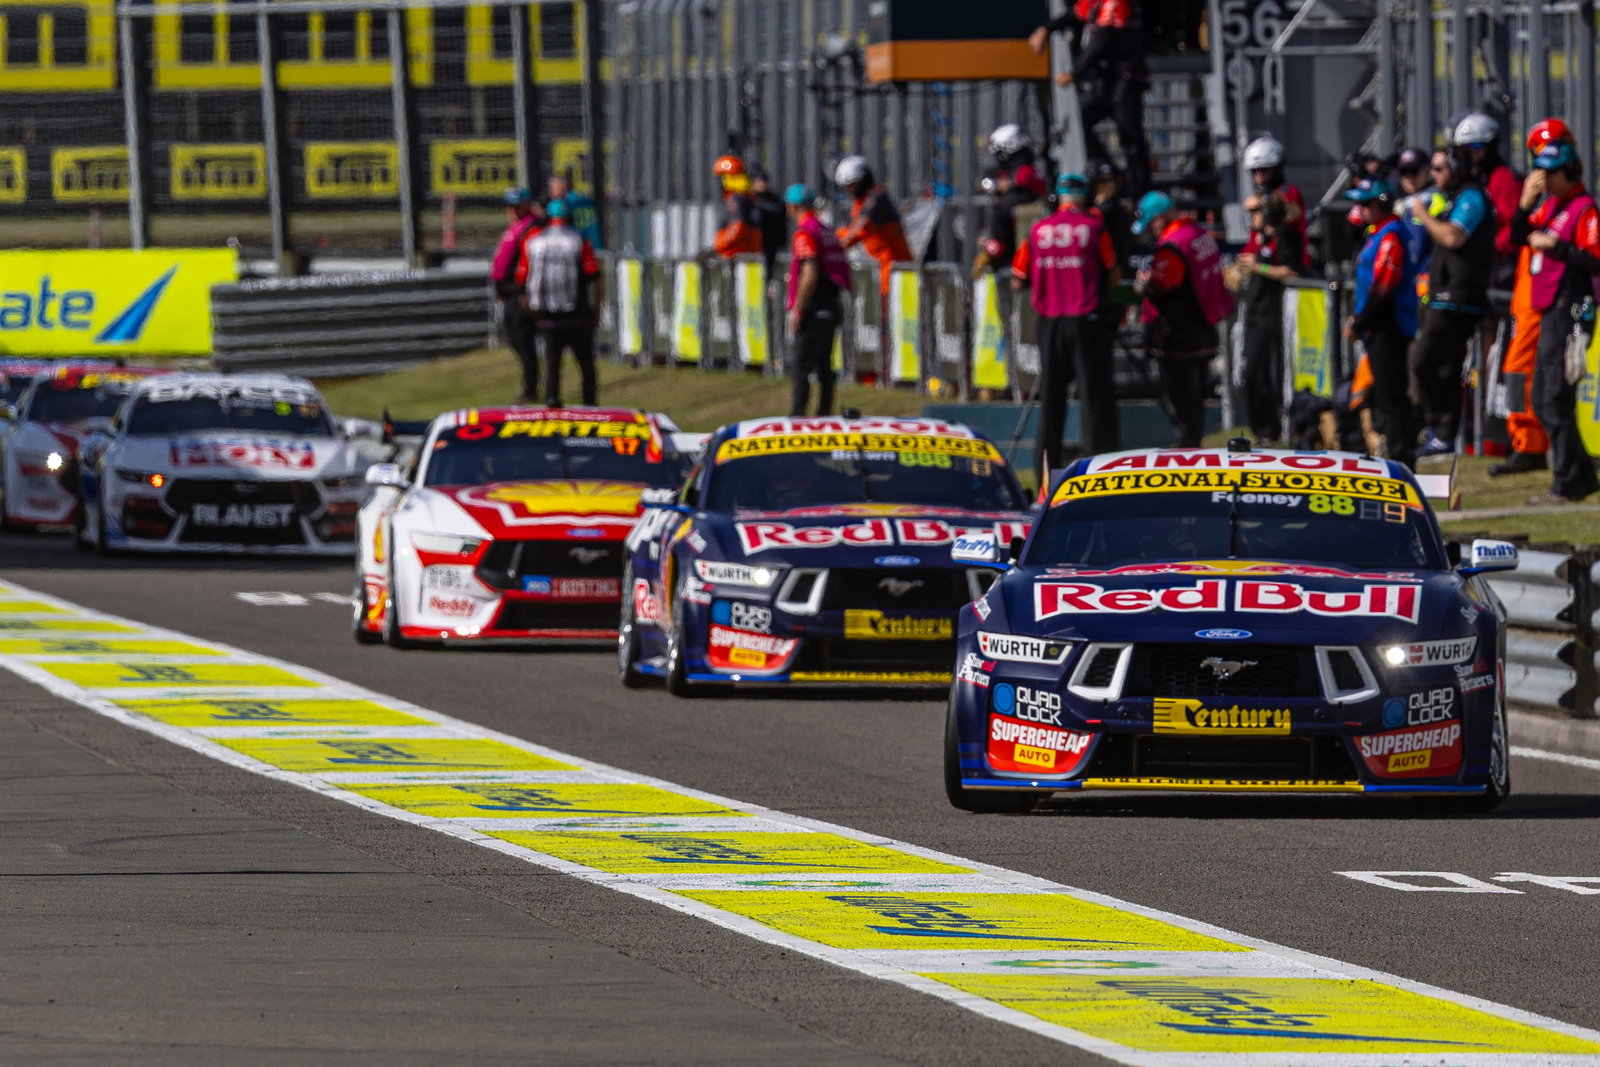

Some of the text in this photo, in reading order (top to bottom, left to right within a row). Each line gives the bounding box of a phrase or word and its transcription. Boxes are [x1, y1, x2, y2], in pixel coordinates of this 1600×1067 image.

[1036, 223, 1090, 249] 331
[0, 274, 94, 330] ate
[746, 421, 967, 437] AMPOL
[728, 434, 857, 454] NATIONAL
[899, 451, 953, 469] 888
[1096, 453, 1383, 475] AMPOL
[1065, 472, 1401, 499] NATIONAL STORAGE
[1308, 493, 1356, 516] 88
[735, 518, 895, 556] Red
[1475, 544, 1518, 558] Thrifty
[1034, 579, 1227, 622] Red
[1234, 580, 1423, 625] Bull
[1204, 628, 1242, 638] Ford
[989, 637, 1041, 658] WÜRTH
[1427, 642, 1472, 661] WÜRTH
[1016, 686, 1061, 710] QUAD
[1408, 687, 1454, 709] QUAD
[1016, 702, 1062, 726] LOCK
[1153, 697, 1292, 736] Century
[1408, 703, 1454, 726] LOCK
[991, 718, 1091, 754] SUPERCHEAP
[1360, 723, 1461, 758] SUPERCHEAP
[1018, 749, 1051, 762] AUTO
[1392, 754, 1426, 768] AUTO
